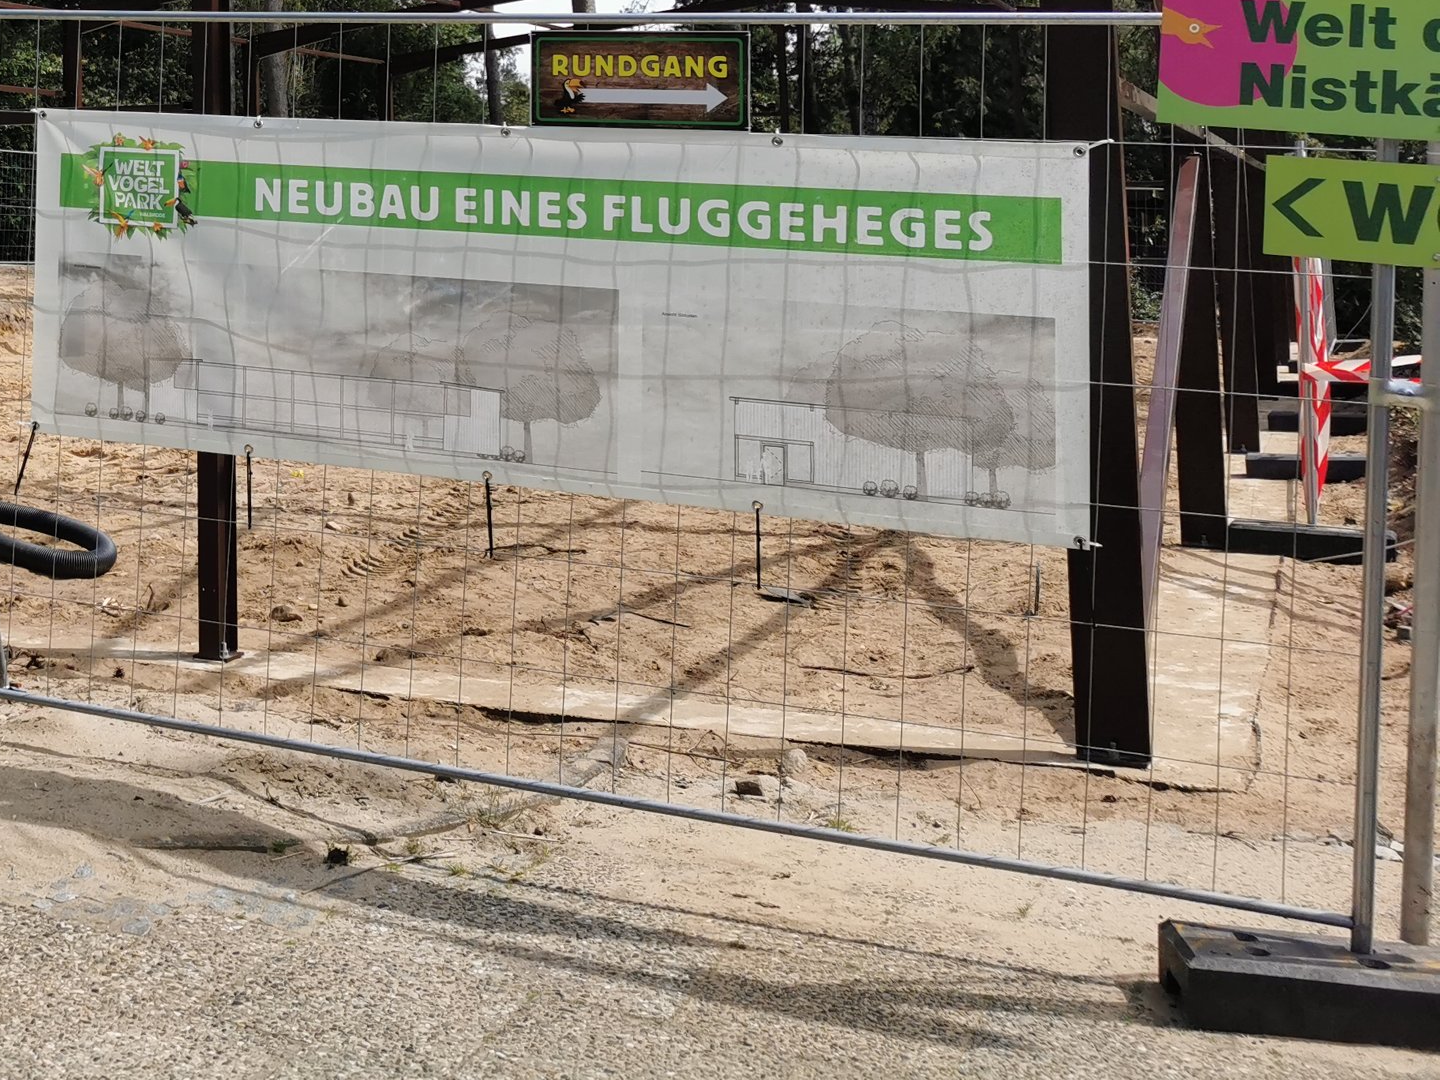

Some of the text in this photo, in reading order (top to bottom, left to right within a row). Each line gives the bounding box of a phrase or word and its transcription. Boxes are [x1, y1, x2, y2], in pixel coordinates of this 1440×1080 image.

[1240, 0, 1396, 50] Welt
[552, 54, 728, 78] RUNDGANG
[114, 159, 165, 176] WELT
[108, 175, 170, 194] VOGEL
[114, 192, 163, 210] PARK
[1342, 180, 1440, 245] W
[255, 177, 993, 251] NEUBAU EINES FLUGGEHEGES
